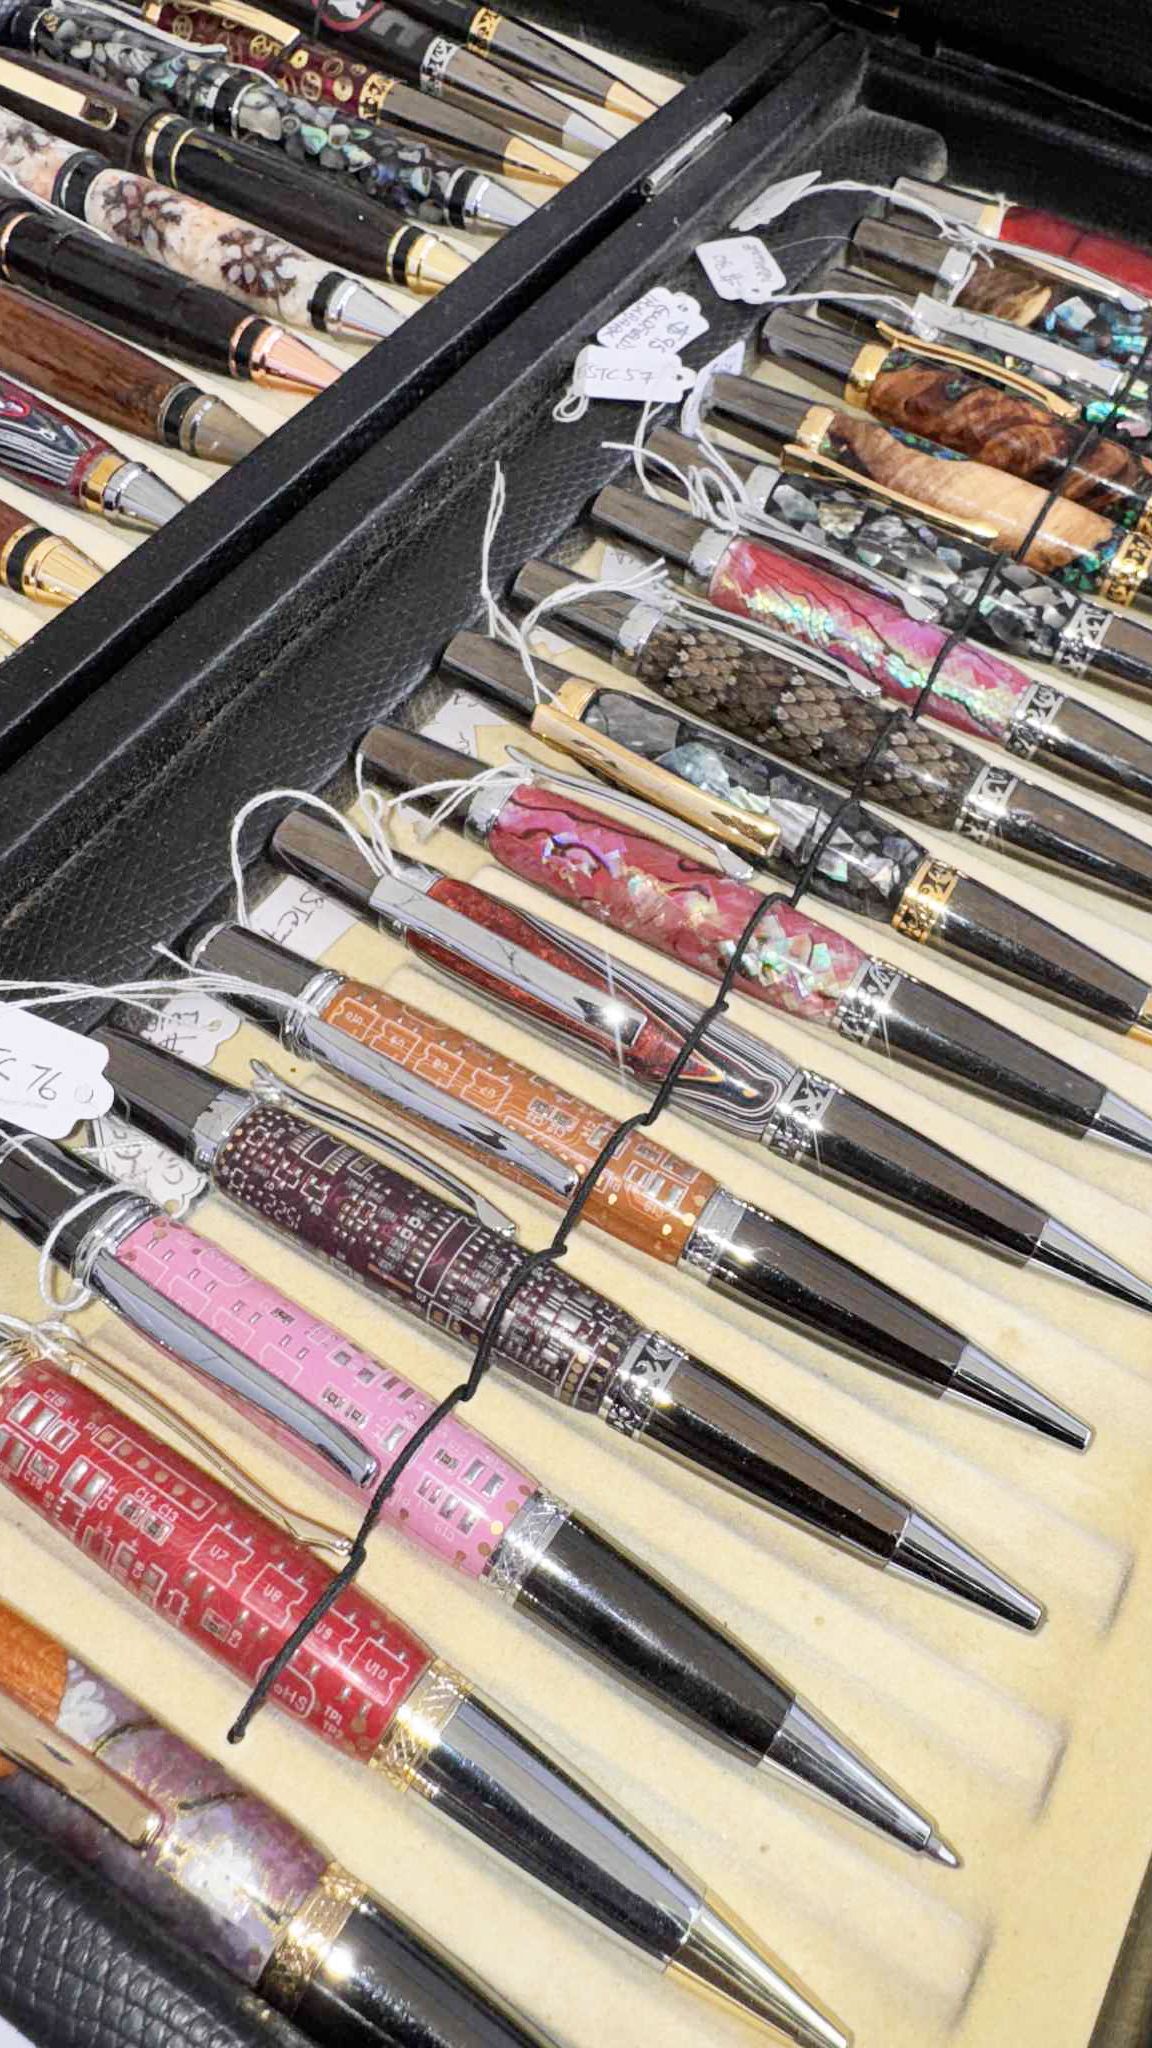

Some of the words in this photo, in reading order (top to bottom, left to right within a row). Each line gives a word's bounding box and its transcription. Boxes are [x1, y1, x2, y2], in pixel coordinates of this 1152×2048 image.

[135, 1486, 157, 1504] C12
[158, 1503, 180, 1523] C13
[209, 1543, 230, 1561] U7
[263, 1583, 283, 1602] U8
[364, 1659, 389, 1680] U10
[323, 1705, 344, 1725] TP1
